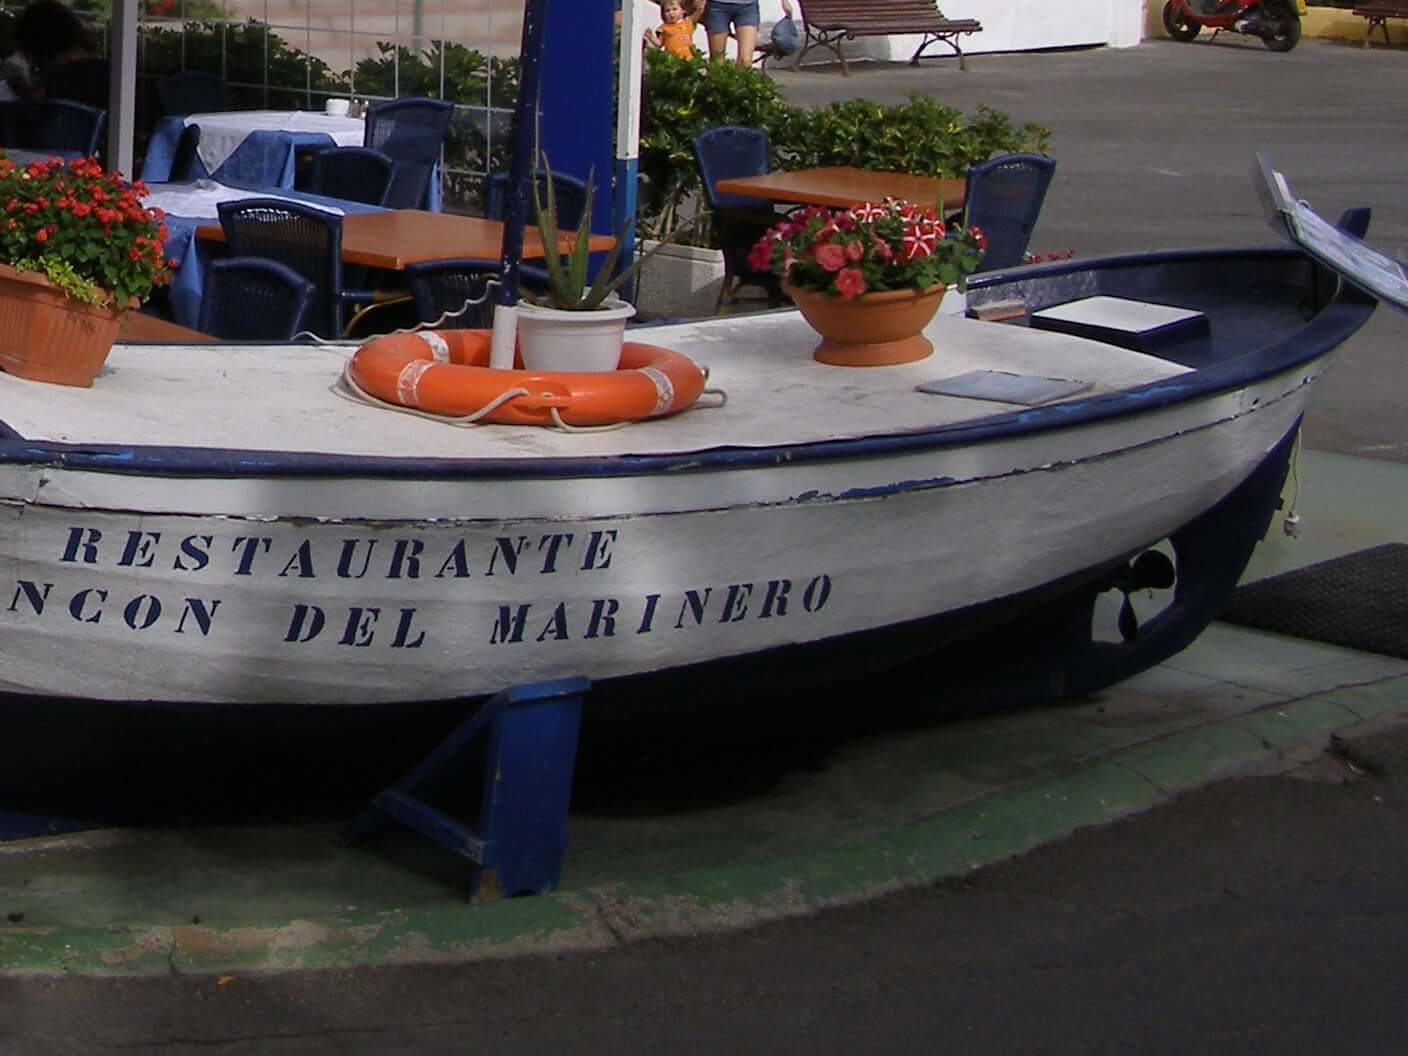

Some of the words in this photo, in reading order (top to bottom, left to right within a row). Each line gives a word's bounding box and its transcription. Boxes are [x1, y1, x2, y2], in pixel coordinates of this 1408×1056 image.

[59, 527, 620, 580] RESTAURANTE
[282, 604, 428, 650] DEL
[488, 573, 835, 646] MARINERO
